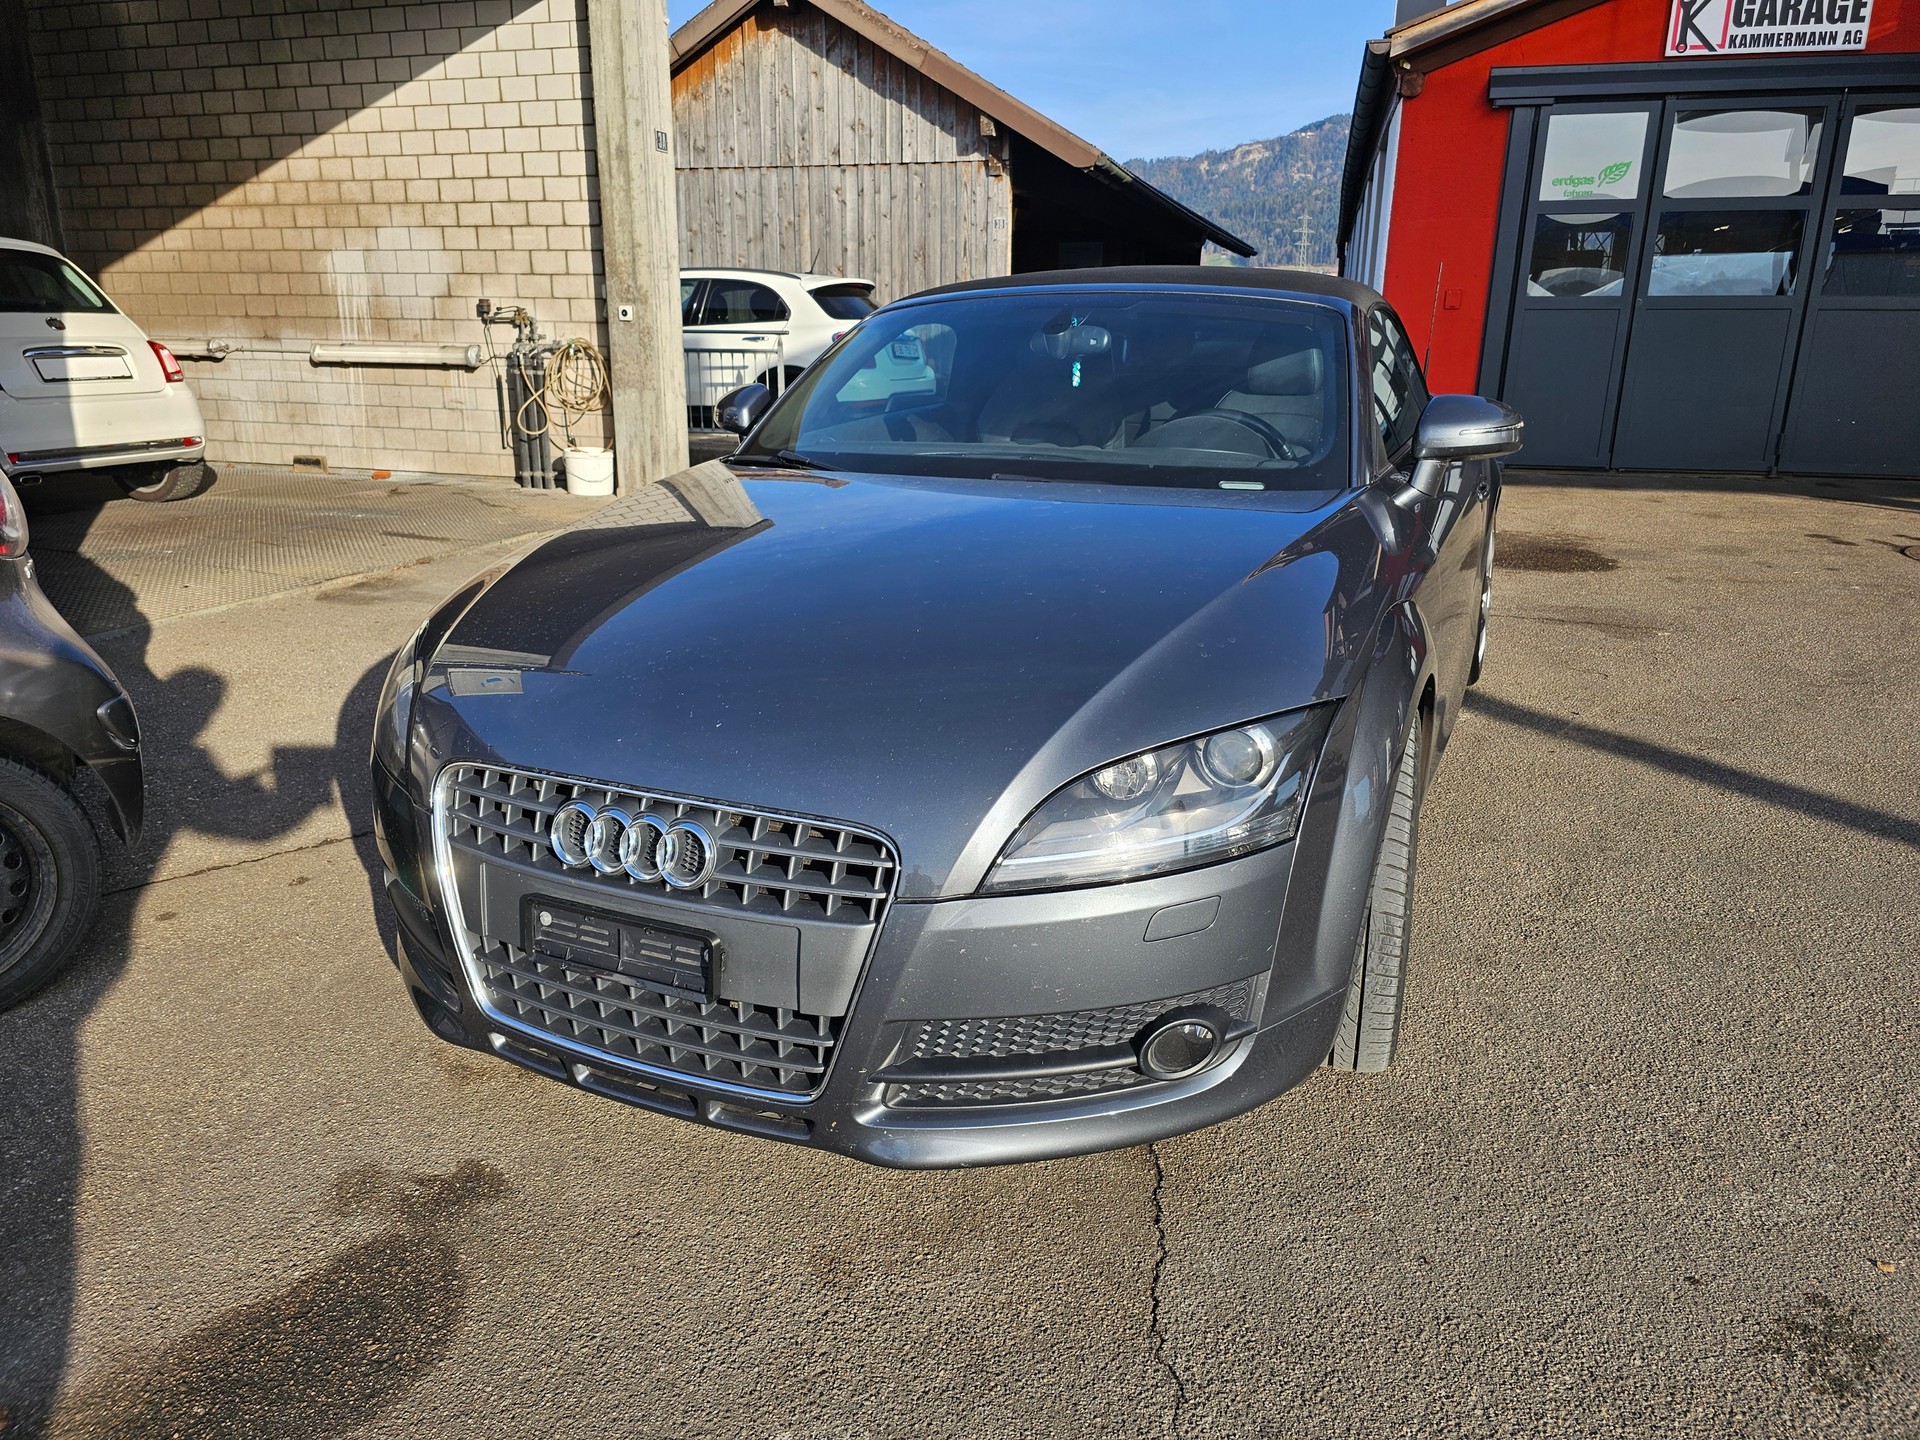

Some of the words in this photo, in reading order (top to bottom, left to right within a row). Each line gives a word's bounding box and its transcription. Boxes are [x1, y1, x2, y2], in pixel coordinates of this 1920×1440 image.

[1732, 0, 1867, 28] GARAGE
[1728, 31, 1838, 49] KAMMERMANN
[1843, 29, 1863, 45] AG
[1551, 175, 1595, 187] erdgas
